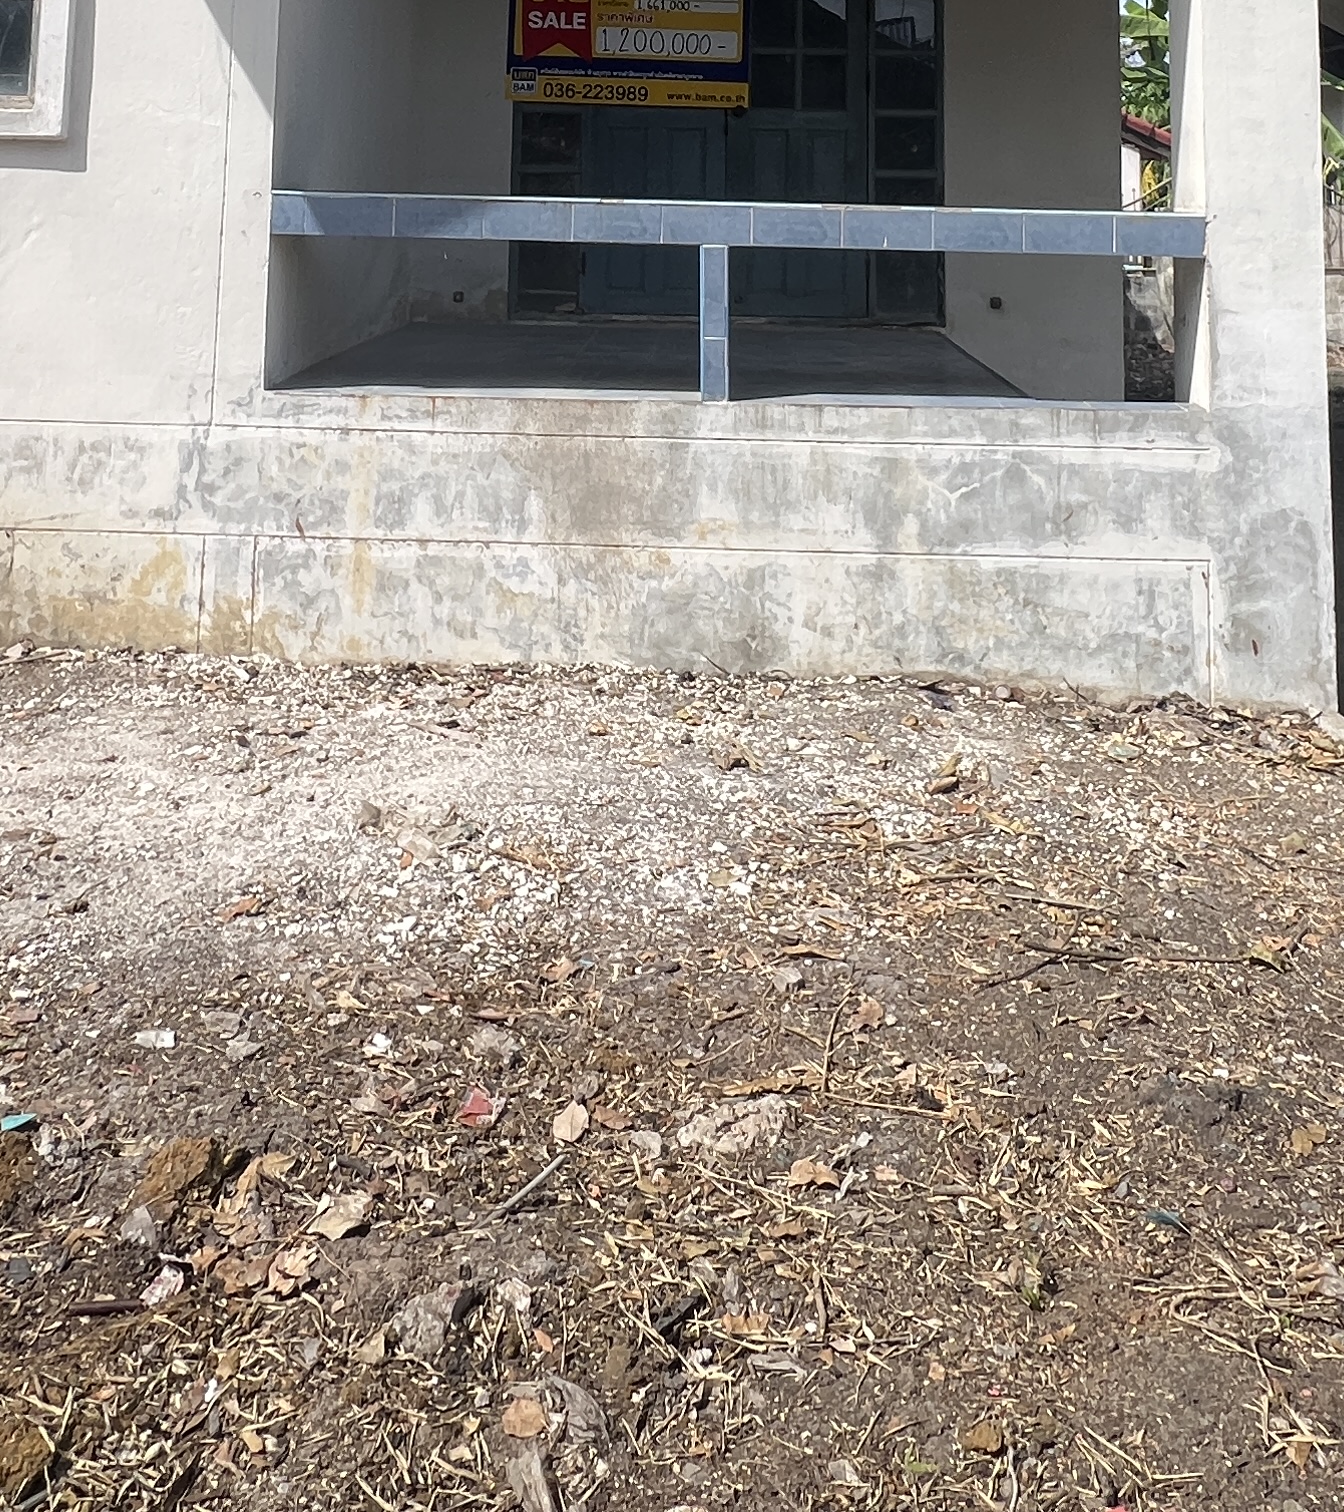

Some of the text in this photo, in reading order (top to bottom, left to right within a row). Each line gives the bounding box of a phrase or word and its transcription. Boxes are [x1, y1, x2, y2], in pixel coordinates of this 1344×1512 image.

[528, 11, 586, 29] SALE
[513, 83, 534, 92] BAM
[543, 82, 649, 102] 036-223989
[666, 92, 745, 103] www.bam.co.th
